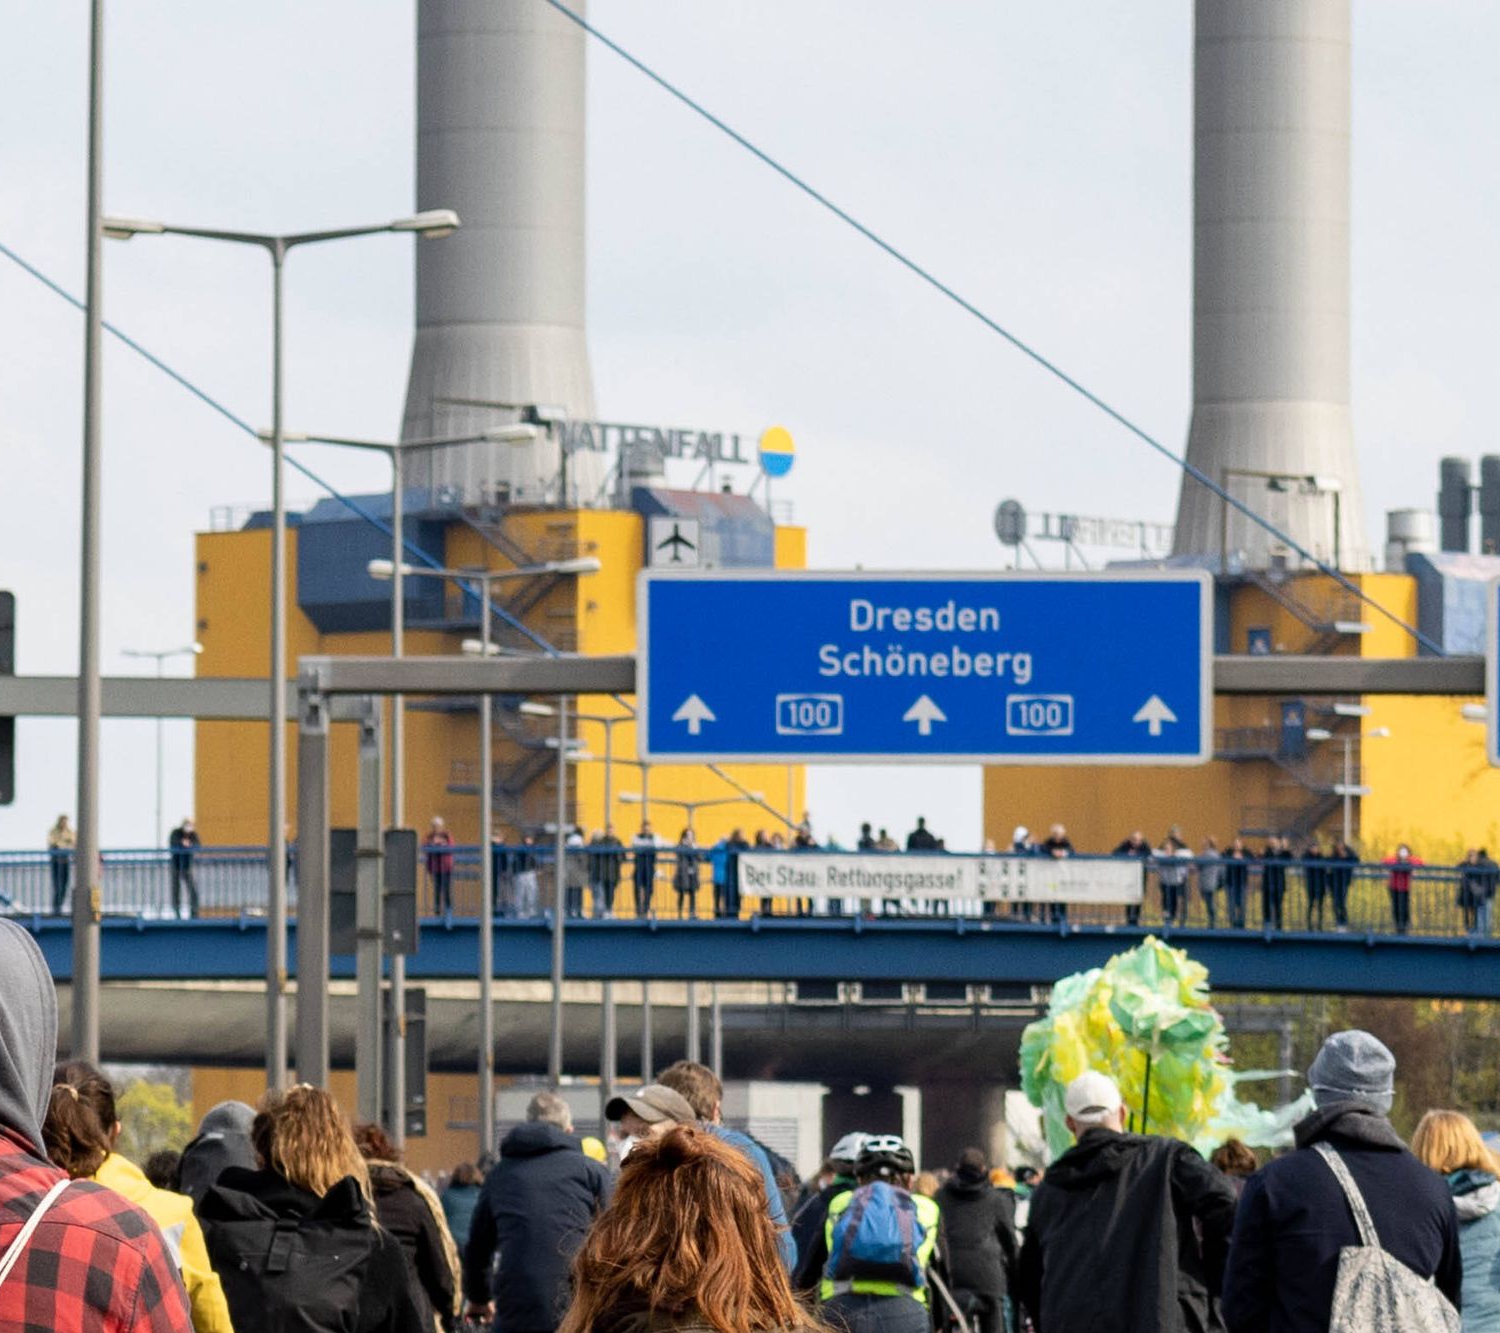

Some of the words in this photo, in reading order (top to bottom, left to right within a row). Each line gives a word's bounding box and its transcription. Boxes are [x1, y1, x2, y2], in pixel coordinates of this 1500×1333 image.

[850, 599, 1000, 632] Dresden
[818, 643, 1033, 685] Schöneberg
[789, 701, 832, 728] 100
[1019, 702, 1062, 728] 100
[827, 865, 964, 893] Rettungsgasse!
